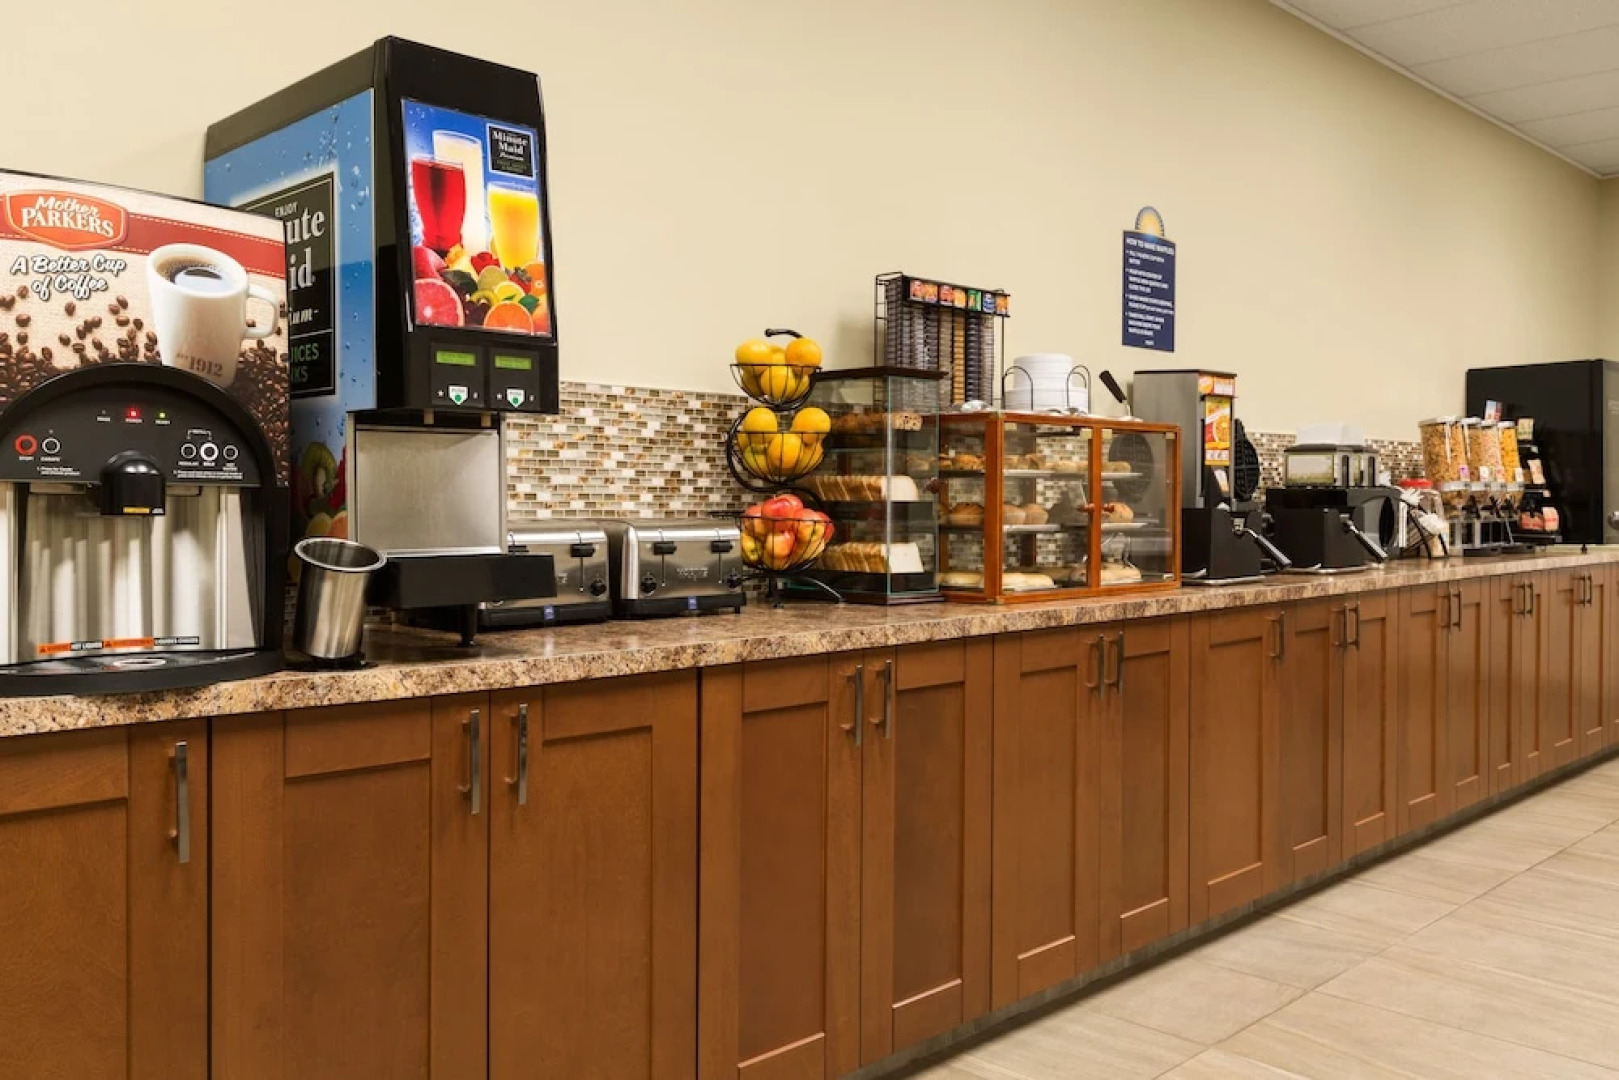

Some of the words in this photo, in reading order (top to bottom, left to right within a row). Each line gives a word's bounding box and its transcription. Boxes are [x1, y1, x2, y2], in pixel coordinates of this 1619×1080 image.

[36, 195, 101, 218] Mother
[275, 201, 298, 217] ENJOY
[21, 207, 115, 238] PARKERS
[10, 255, 28, 275] A
[31, 254, 91, 274] Better
[92, 253, 127, 278] Cup
[31, 274, 53, 301] of
[54, 274, 109, 300] Coffee
[190, 355, 223, 377] 1912
